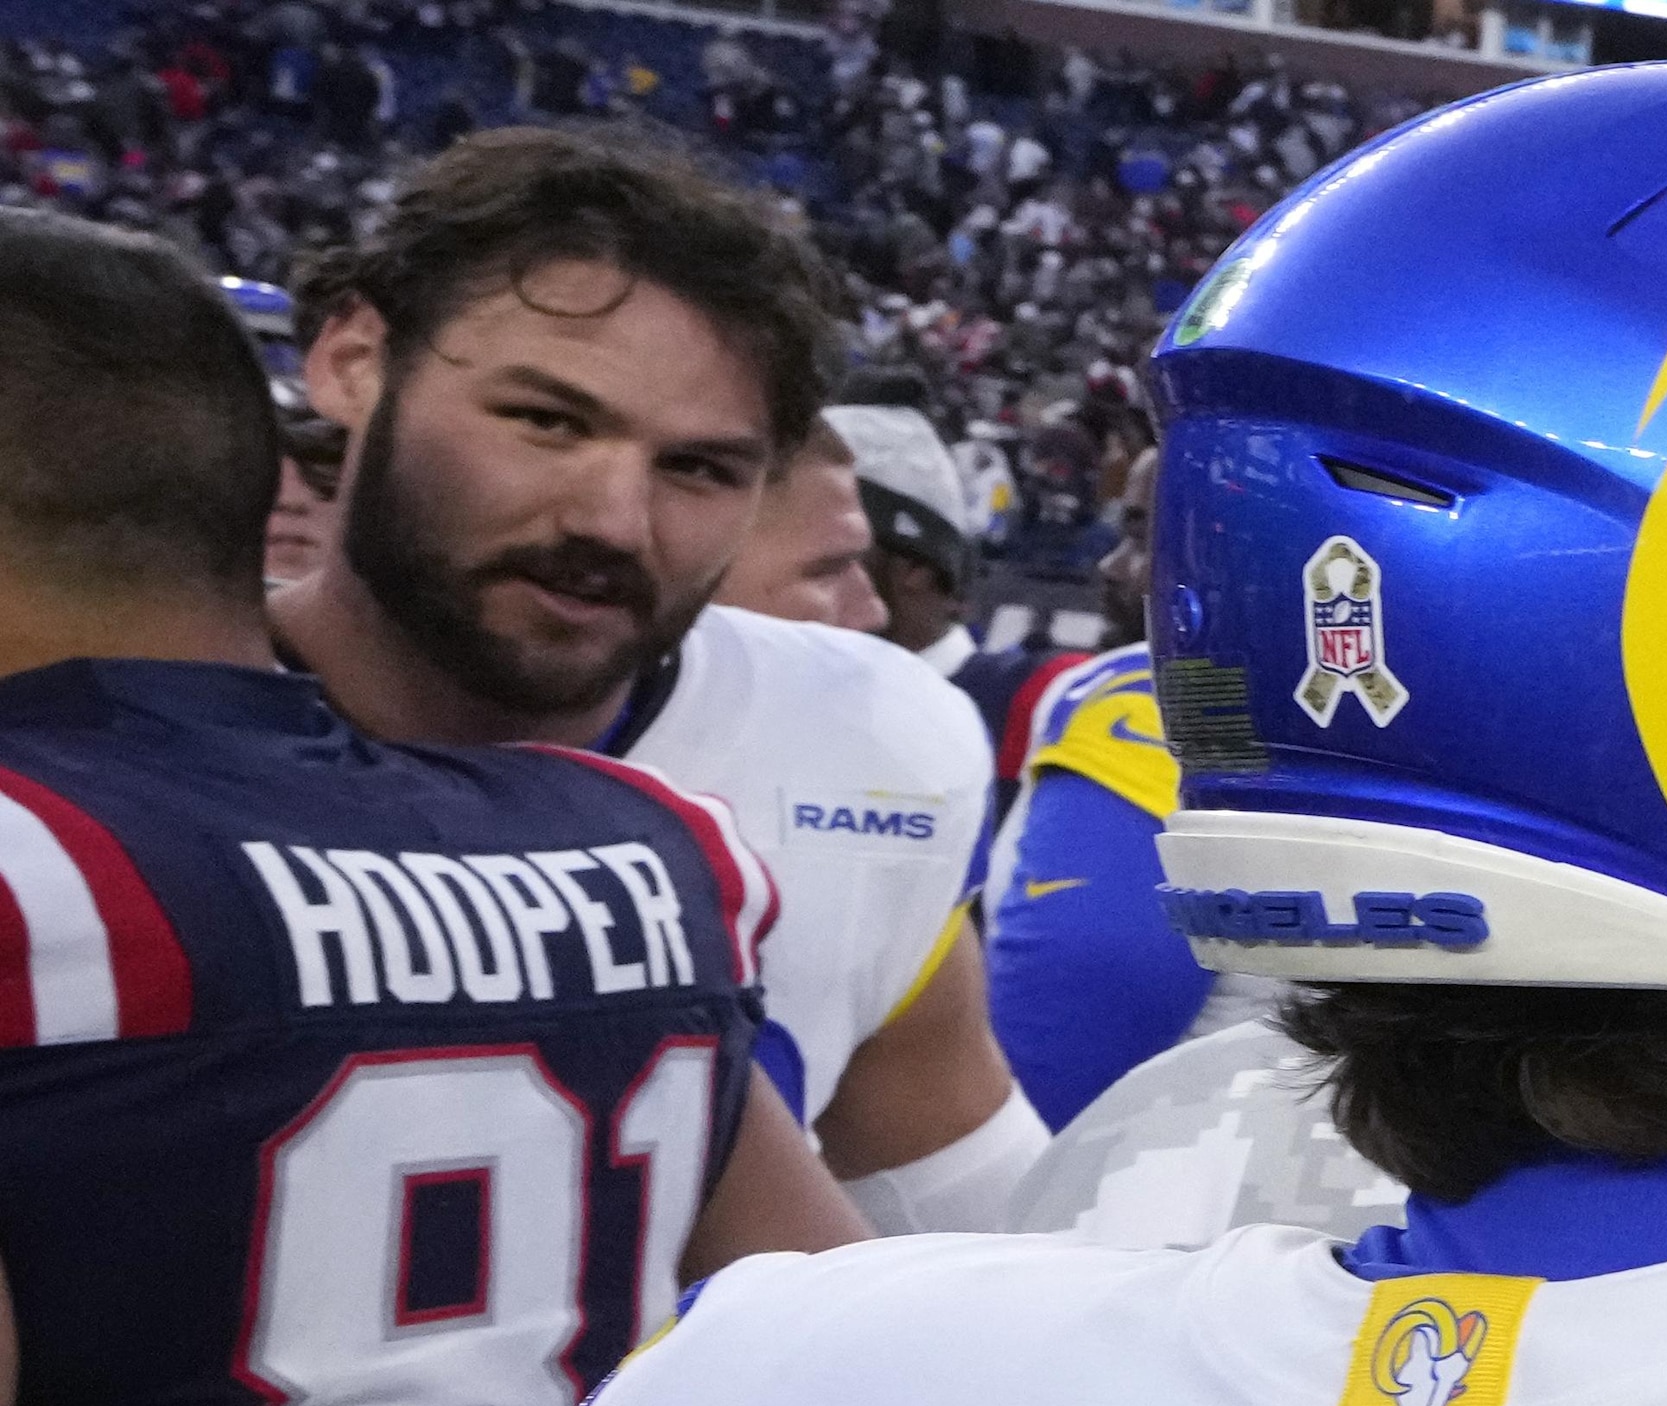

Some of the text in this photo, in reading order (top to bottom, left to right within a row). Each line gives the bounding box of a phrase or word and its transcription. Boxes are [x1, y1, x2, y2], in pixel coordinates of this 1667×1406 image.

[1319, 628, 1371, 669] NFL
[794, 804, 936, 839] RAMS
[242, 841, 697, 1008] HOOPER
